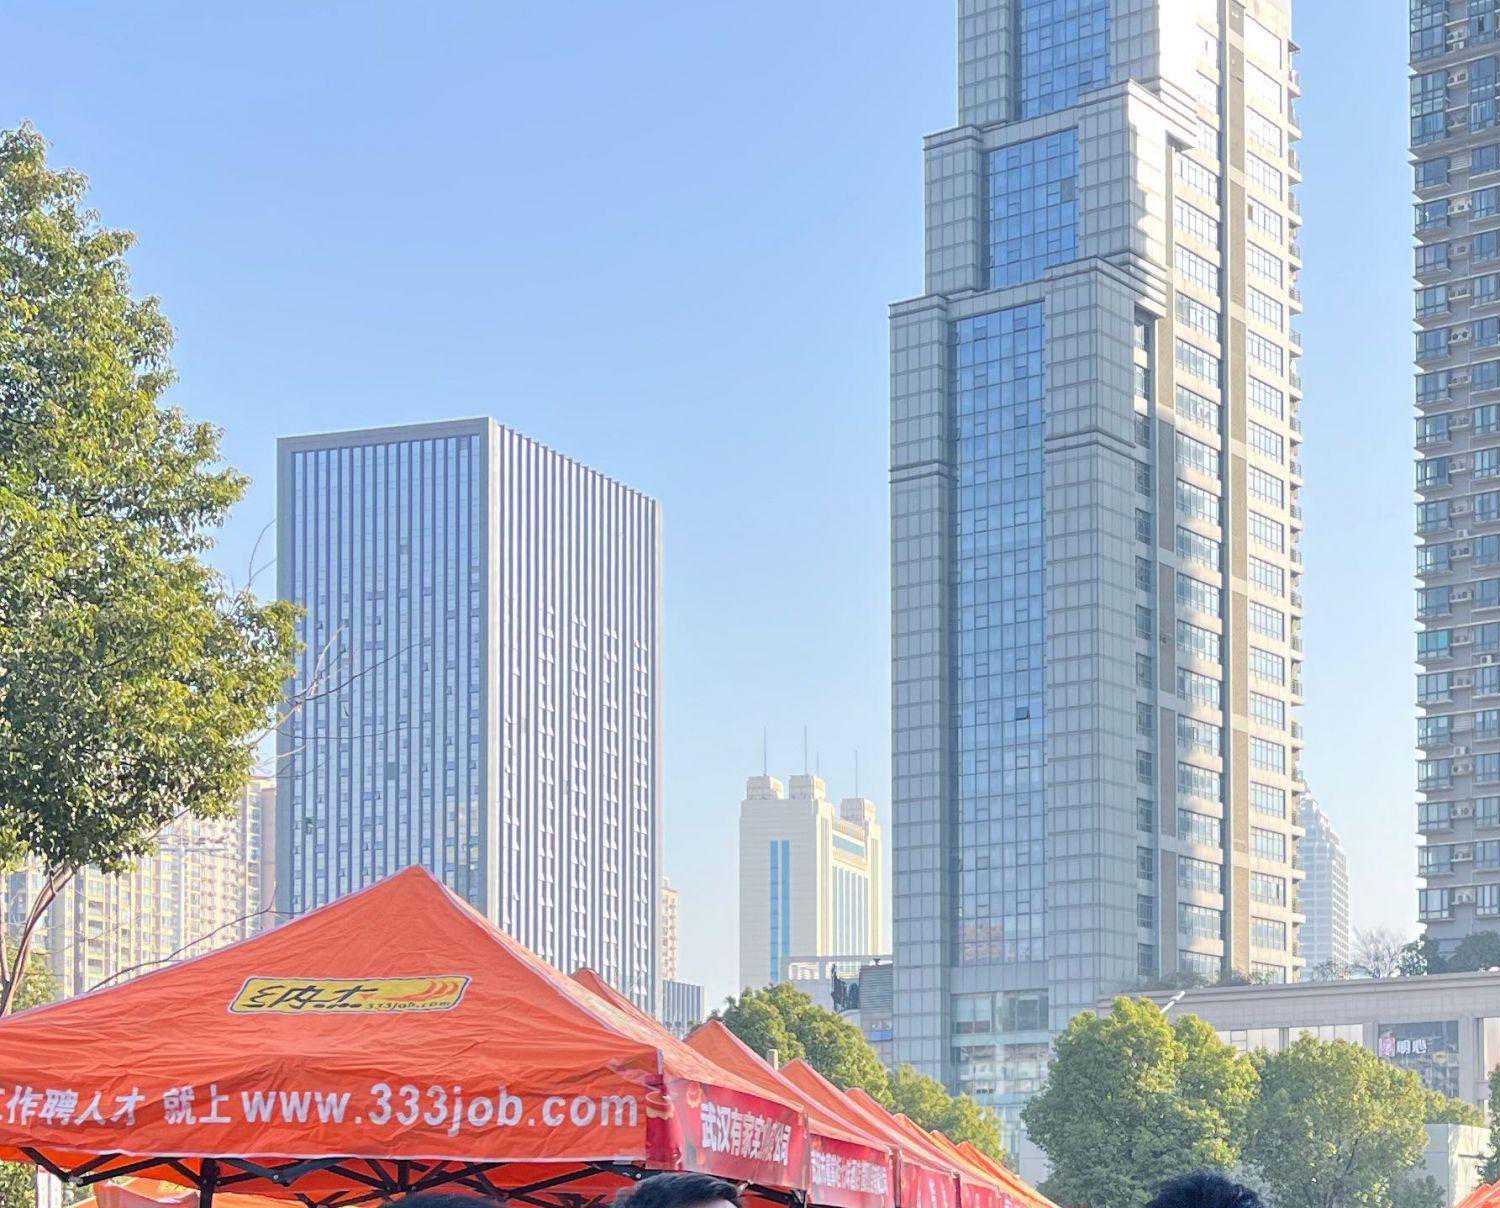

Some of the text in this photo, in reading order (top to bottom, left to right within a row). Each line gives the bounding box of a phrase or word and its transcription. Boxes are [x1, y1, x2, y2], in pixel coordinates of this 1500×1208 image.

[0, 1083, 639, 1137] 作聘人才 就上 www.333job.com
